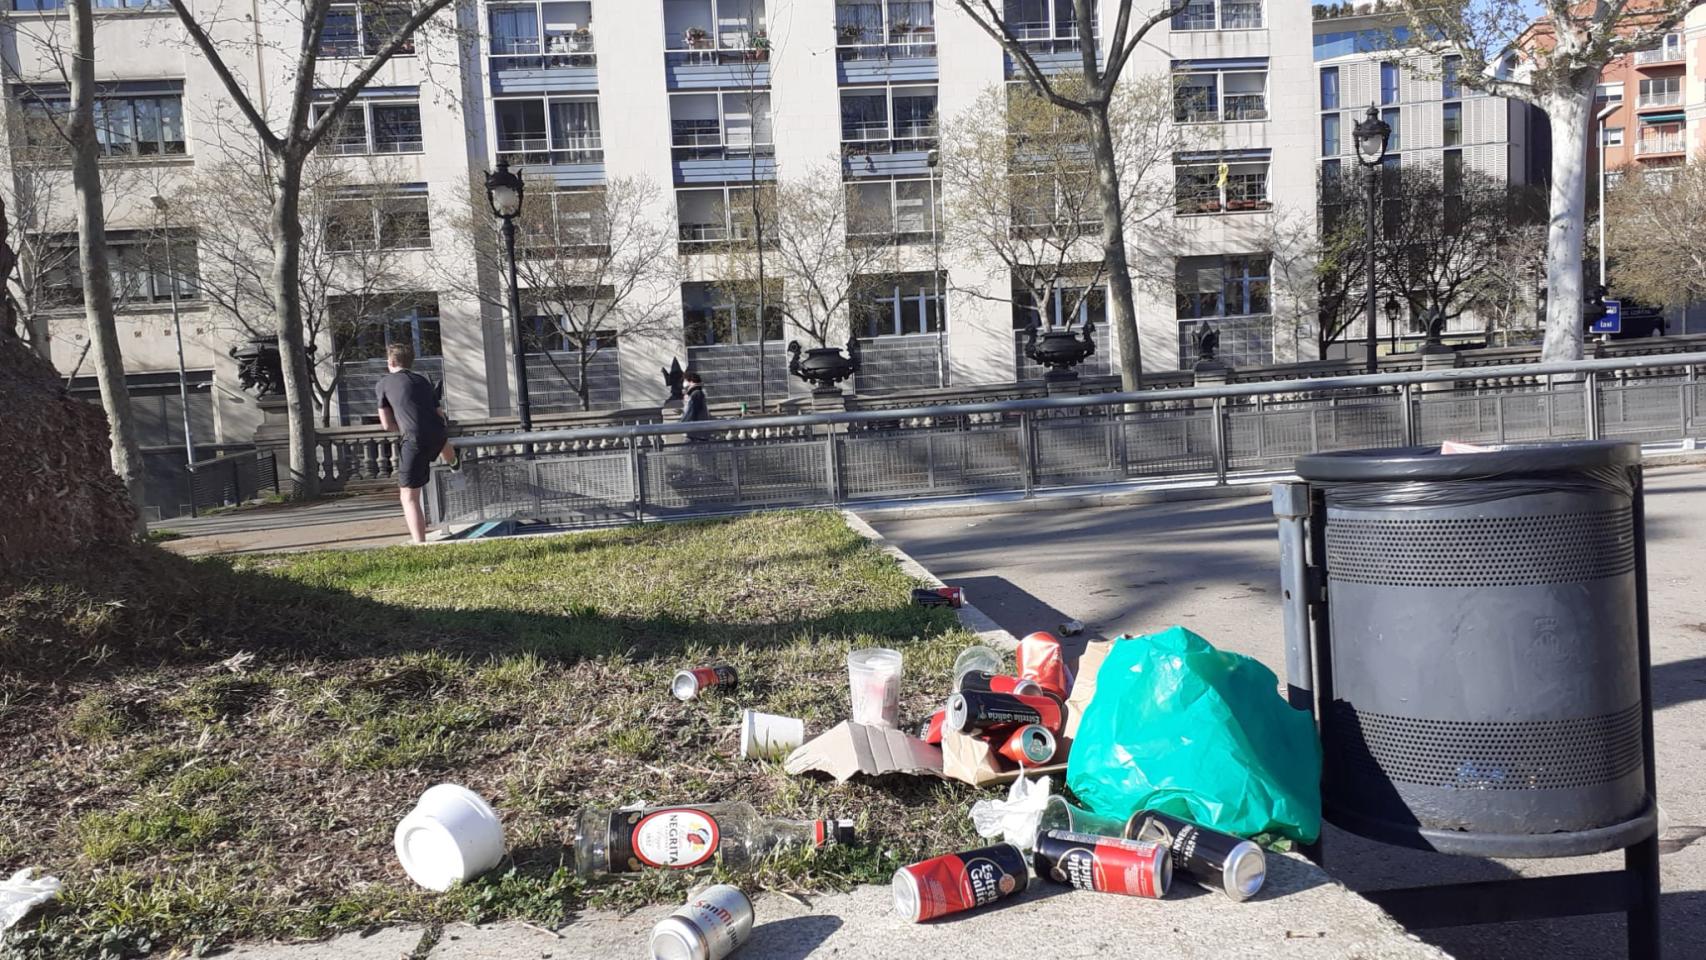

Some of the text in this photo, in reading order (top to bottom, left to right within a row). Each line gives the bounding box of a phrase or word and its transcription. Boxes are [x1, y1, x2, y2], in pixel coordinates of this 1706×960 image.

[669, 814, 678, 864] NEGRITA
[981, 863, 998, 901] Estrel
[1067, 854, 1082, 890] strella
[1079, 858, 1094, 891] alicia
